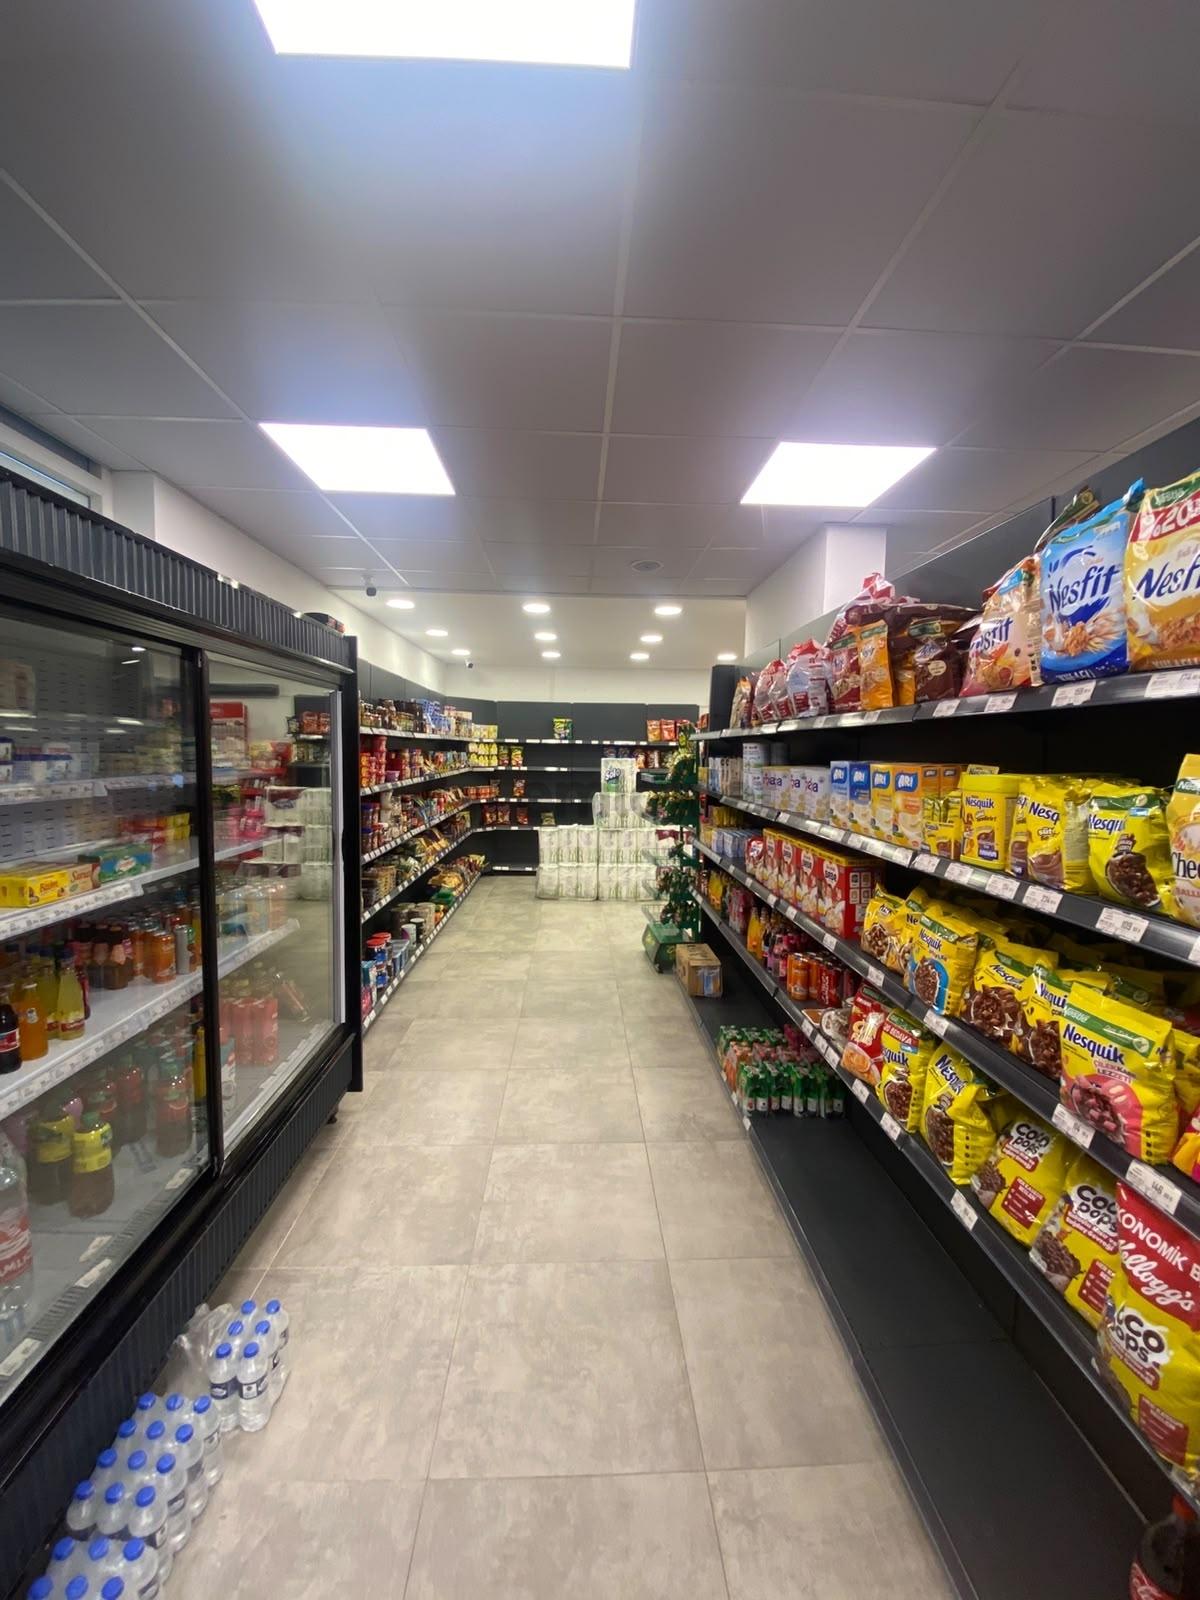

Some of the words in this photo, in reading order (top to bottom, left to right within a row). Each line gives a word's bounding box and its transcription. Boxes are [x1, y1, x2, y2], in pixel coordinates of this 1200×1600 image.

[1049, 564, 1120, 613] Nesfit
[965, 795, 994, 809] Nesquik
[919, 929, 943, 952] Nesquik
[1063, 1023, 1125, 1065] Nesquik
